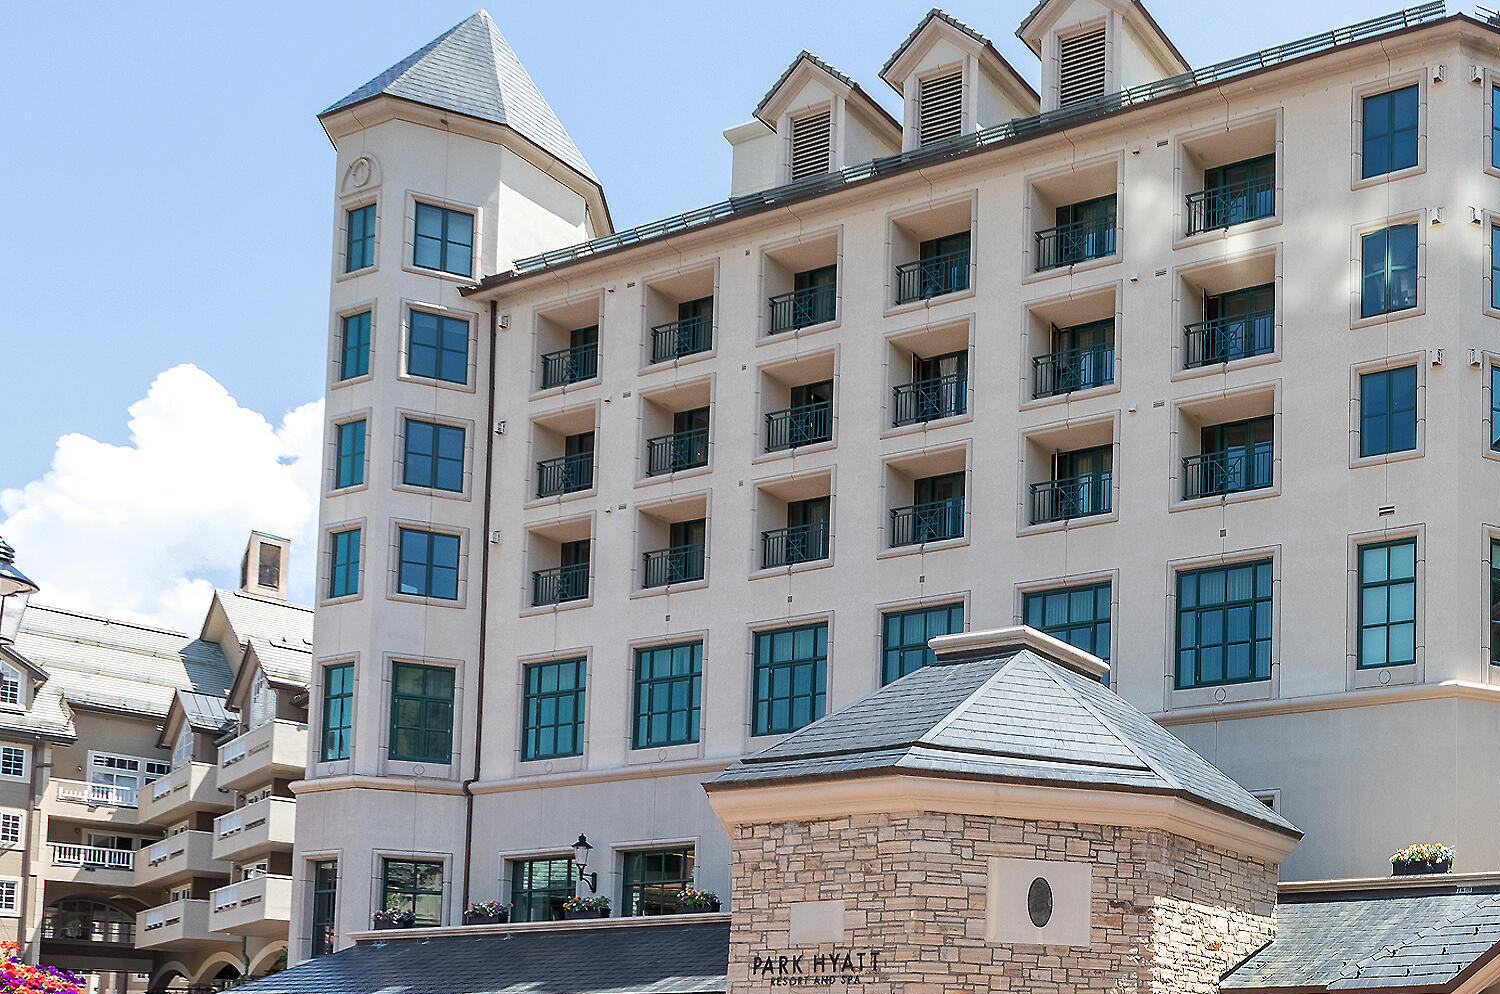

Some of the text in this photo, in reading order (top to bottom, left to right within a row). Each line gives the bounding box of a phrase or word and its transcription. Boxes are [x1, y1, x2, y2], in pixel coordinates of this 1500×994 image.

[752, 951, 881, 976] PARK HYATT
[770, 975, 861, 986] RESORT AND SPA
